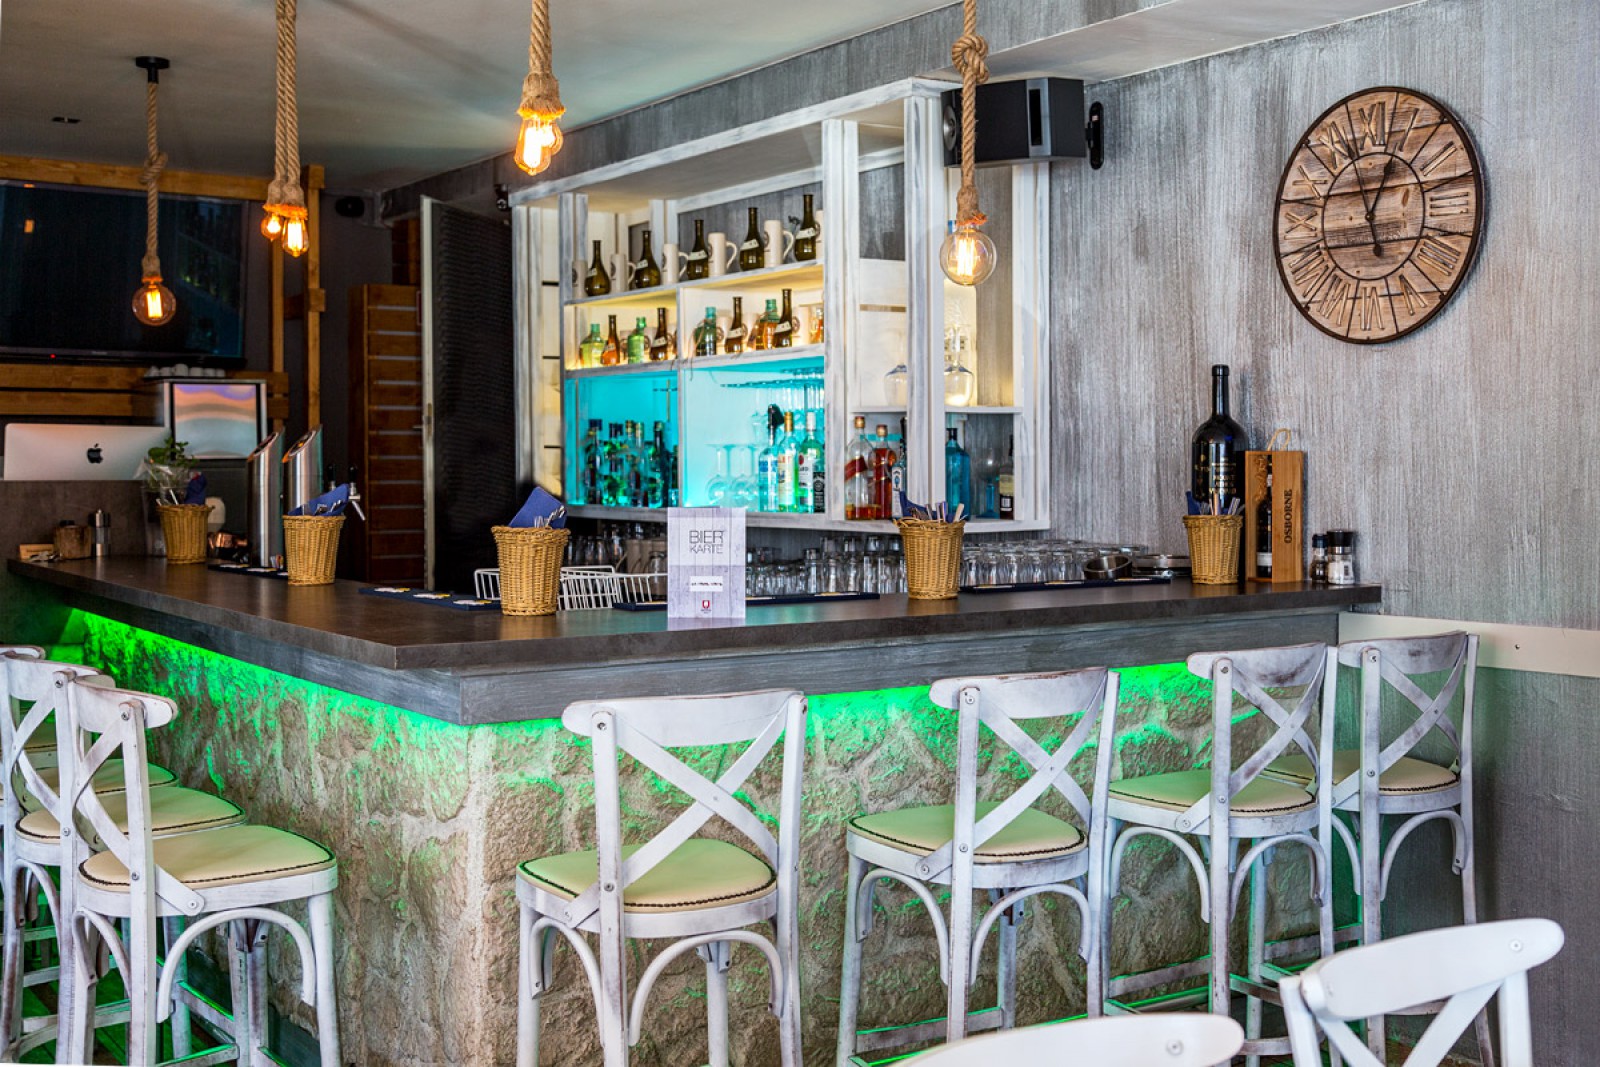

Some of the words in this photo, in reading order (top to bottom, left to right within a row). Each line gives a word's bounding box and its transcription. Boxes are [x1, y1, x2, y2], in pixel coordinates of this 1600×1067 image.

[1292, 165, 1328, 200] X
[1429, 191, 1469, 217] III
[1399, 274, 1429, 316] V
[1284, 489, 1293, 544] OSBORNE
[689, 530, 724, 544] BIER
[689, 544, 724, 554] KARTE
